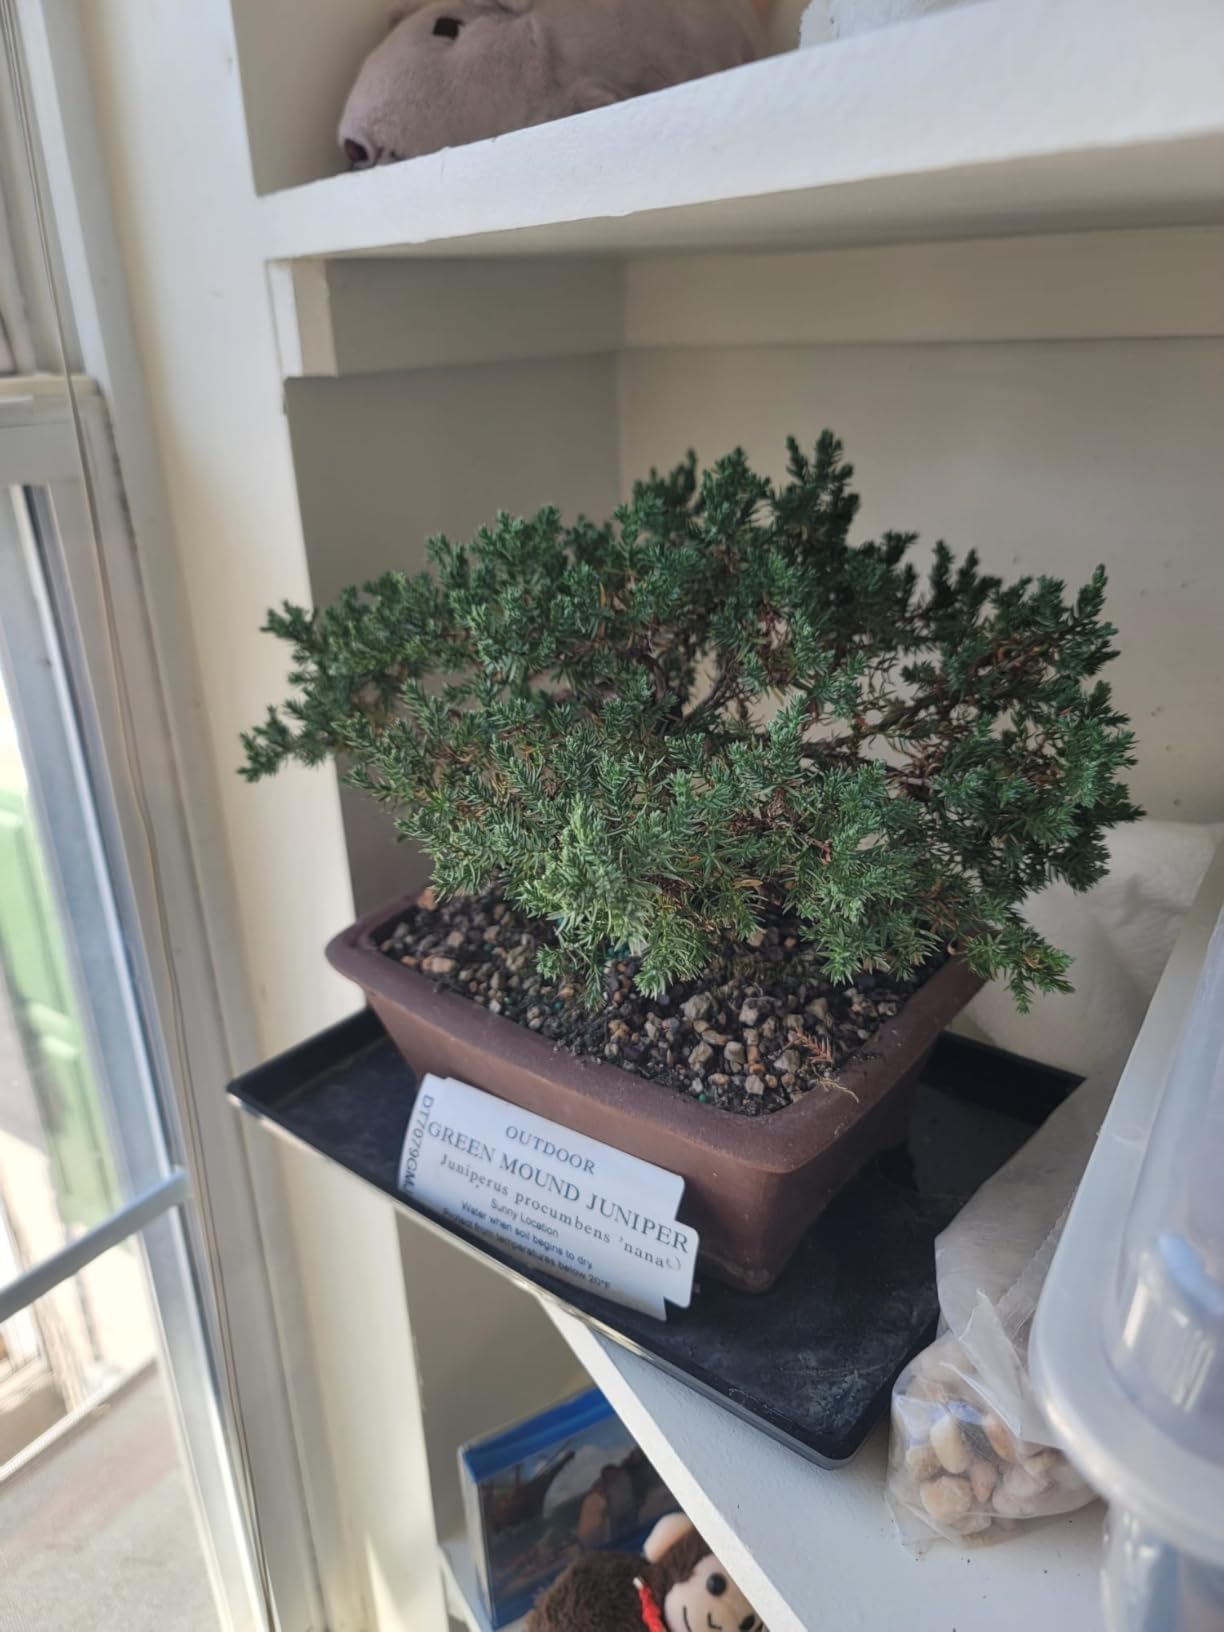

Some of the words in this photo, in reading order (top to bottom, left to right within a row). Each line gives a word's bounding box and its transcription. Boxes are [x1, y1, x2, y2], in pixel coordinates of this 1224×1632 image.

[505, 1125, 596, 1175] OUTDOOR
[428, 1121, 496, 1162] GREEN
[499, 1152, 580, 1202] MOUND
[586, 1193, 688, 1254] JUNIPER
[440, 1154, 509, 1196] Juniperus
[514, 1192, 611, 1243] procumbens
[489, 1214, 513, 1232] when
[533, 1233, 564, 1256] begins
[566, 1249, 576, 1262] to
[577, 1255, 593, 1270] dry
[490, 1199, 518, 1221] Sunny
[520, 1211, 559, 1238] Location
